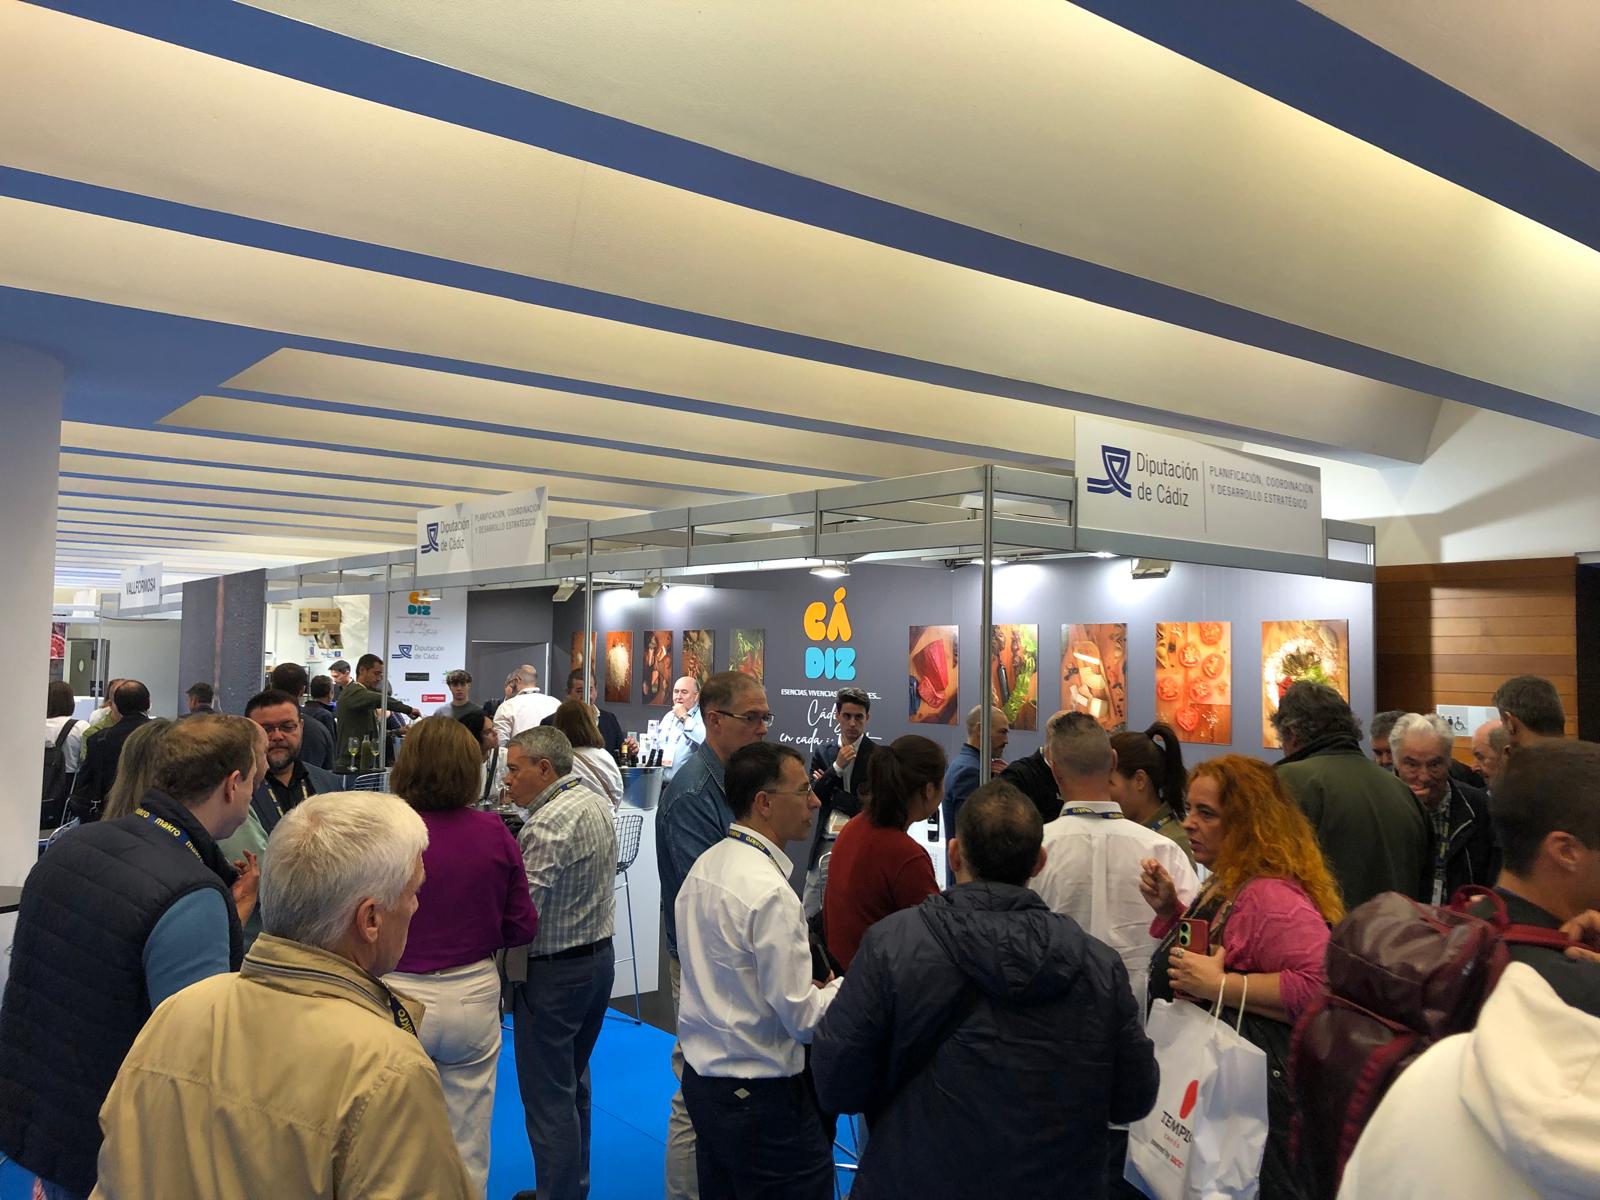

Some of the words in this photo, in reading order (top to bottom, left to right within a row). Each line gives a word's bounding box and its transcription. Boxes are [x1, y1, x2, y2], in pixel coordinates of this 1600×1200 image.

[1136, 452, 1198, 481] Diputación
[1137, 482, 1152, 502] de
[1156, 484, 1189, 507] Cádiz
[1210, 483, 1215, 493] Y
[1217, 484, 1261, 502] DESARROLLO
[407, 604, 431, 616] DIZ
[803, 586, 852, 642] CÁ
[805, 646, 856, 681] DIZ
[154, 817, 181, 837] makro
